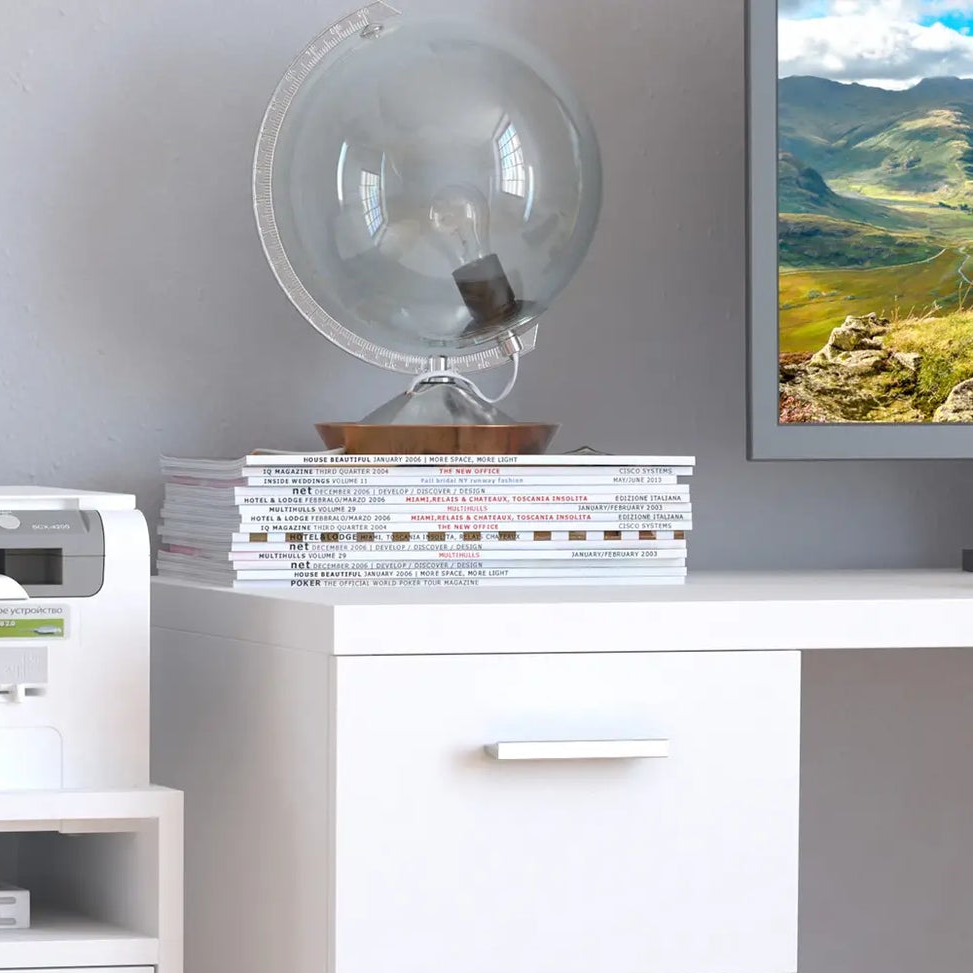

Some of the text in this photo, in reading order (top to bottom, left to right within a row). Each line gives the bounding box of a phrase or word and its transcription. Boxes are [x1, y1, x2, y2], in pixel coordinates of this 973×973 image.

[292, 486, 312, 495] net
[290, 561, 310, 569] net
[10, 605, 63, 615] устройство
